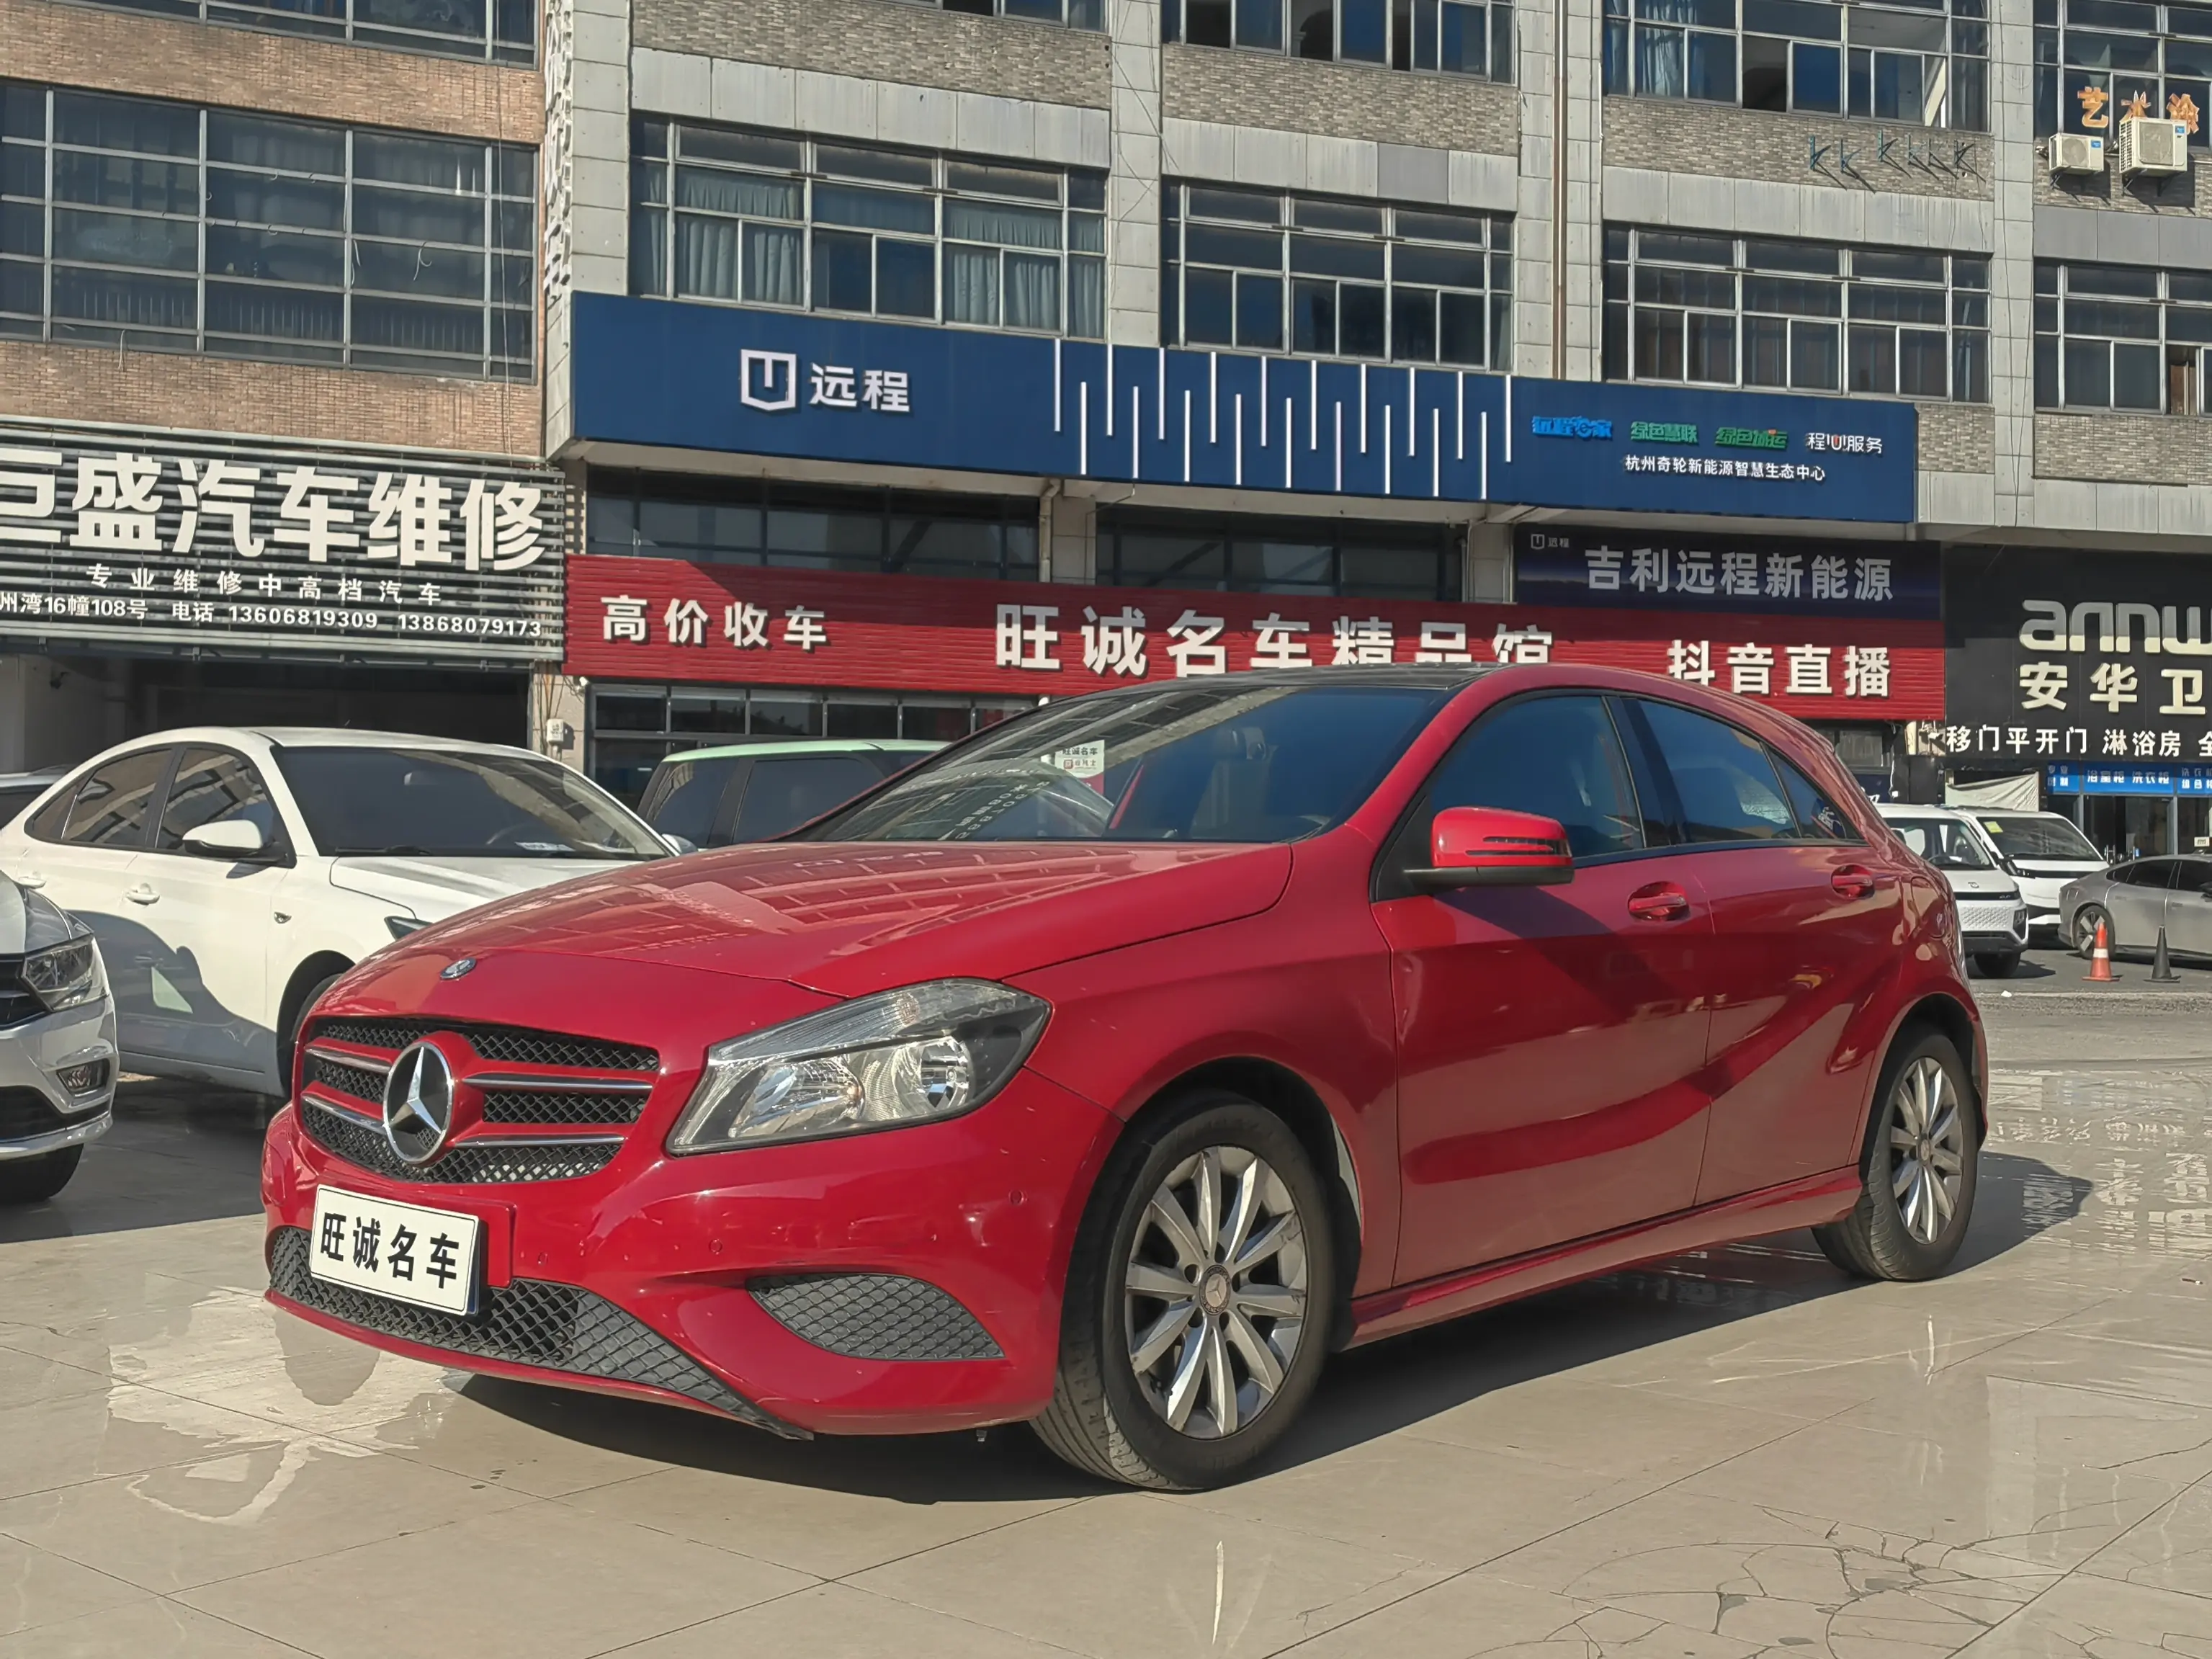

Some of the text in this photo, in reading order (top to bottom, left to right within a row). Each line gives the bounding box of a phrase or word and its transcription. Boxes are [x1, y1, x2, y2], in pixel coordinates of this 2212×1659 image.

[809, 362, 910, 412] 远程
[1625, 455, 1826, 481] 杭州奇轮新能源智慧生态中心
[86, 563, 441, 605] 专业维修中高档汽车
[1585, 545, 1894, 601] 吉利远程新能源
[0, 592, 541, 637] 州湾16幢108号 电话 13606819309 13868079173
[600, 594, 826, 650] 高价收车
[996, 603, 1552, 677] 旺诚名车精品馆
[1667, 640, 1890, 697] 抖音直播
[2020, 661, 2206, 715] 安华卫
[1946, 724, 2087, 754] 移门平开门
[2103, 729, 2181, 756] 淋浴房
[321, 1212, 460, 1289] 旺诚名车
